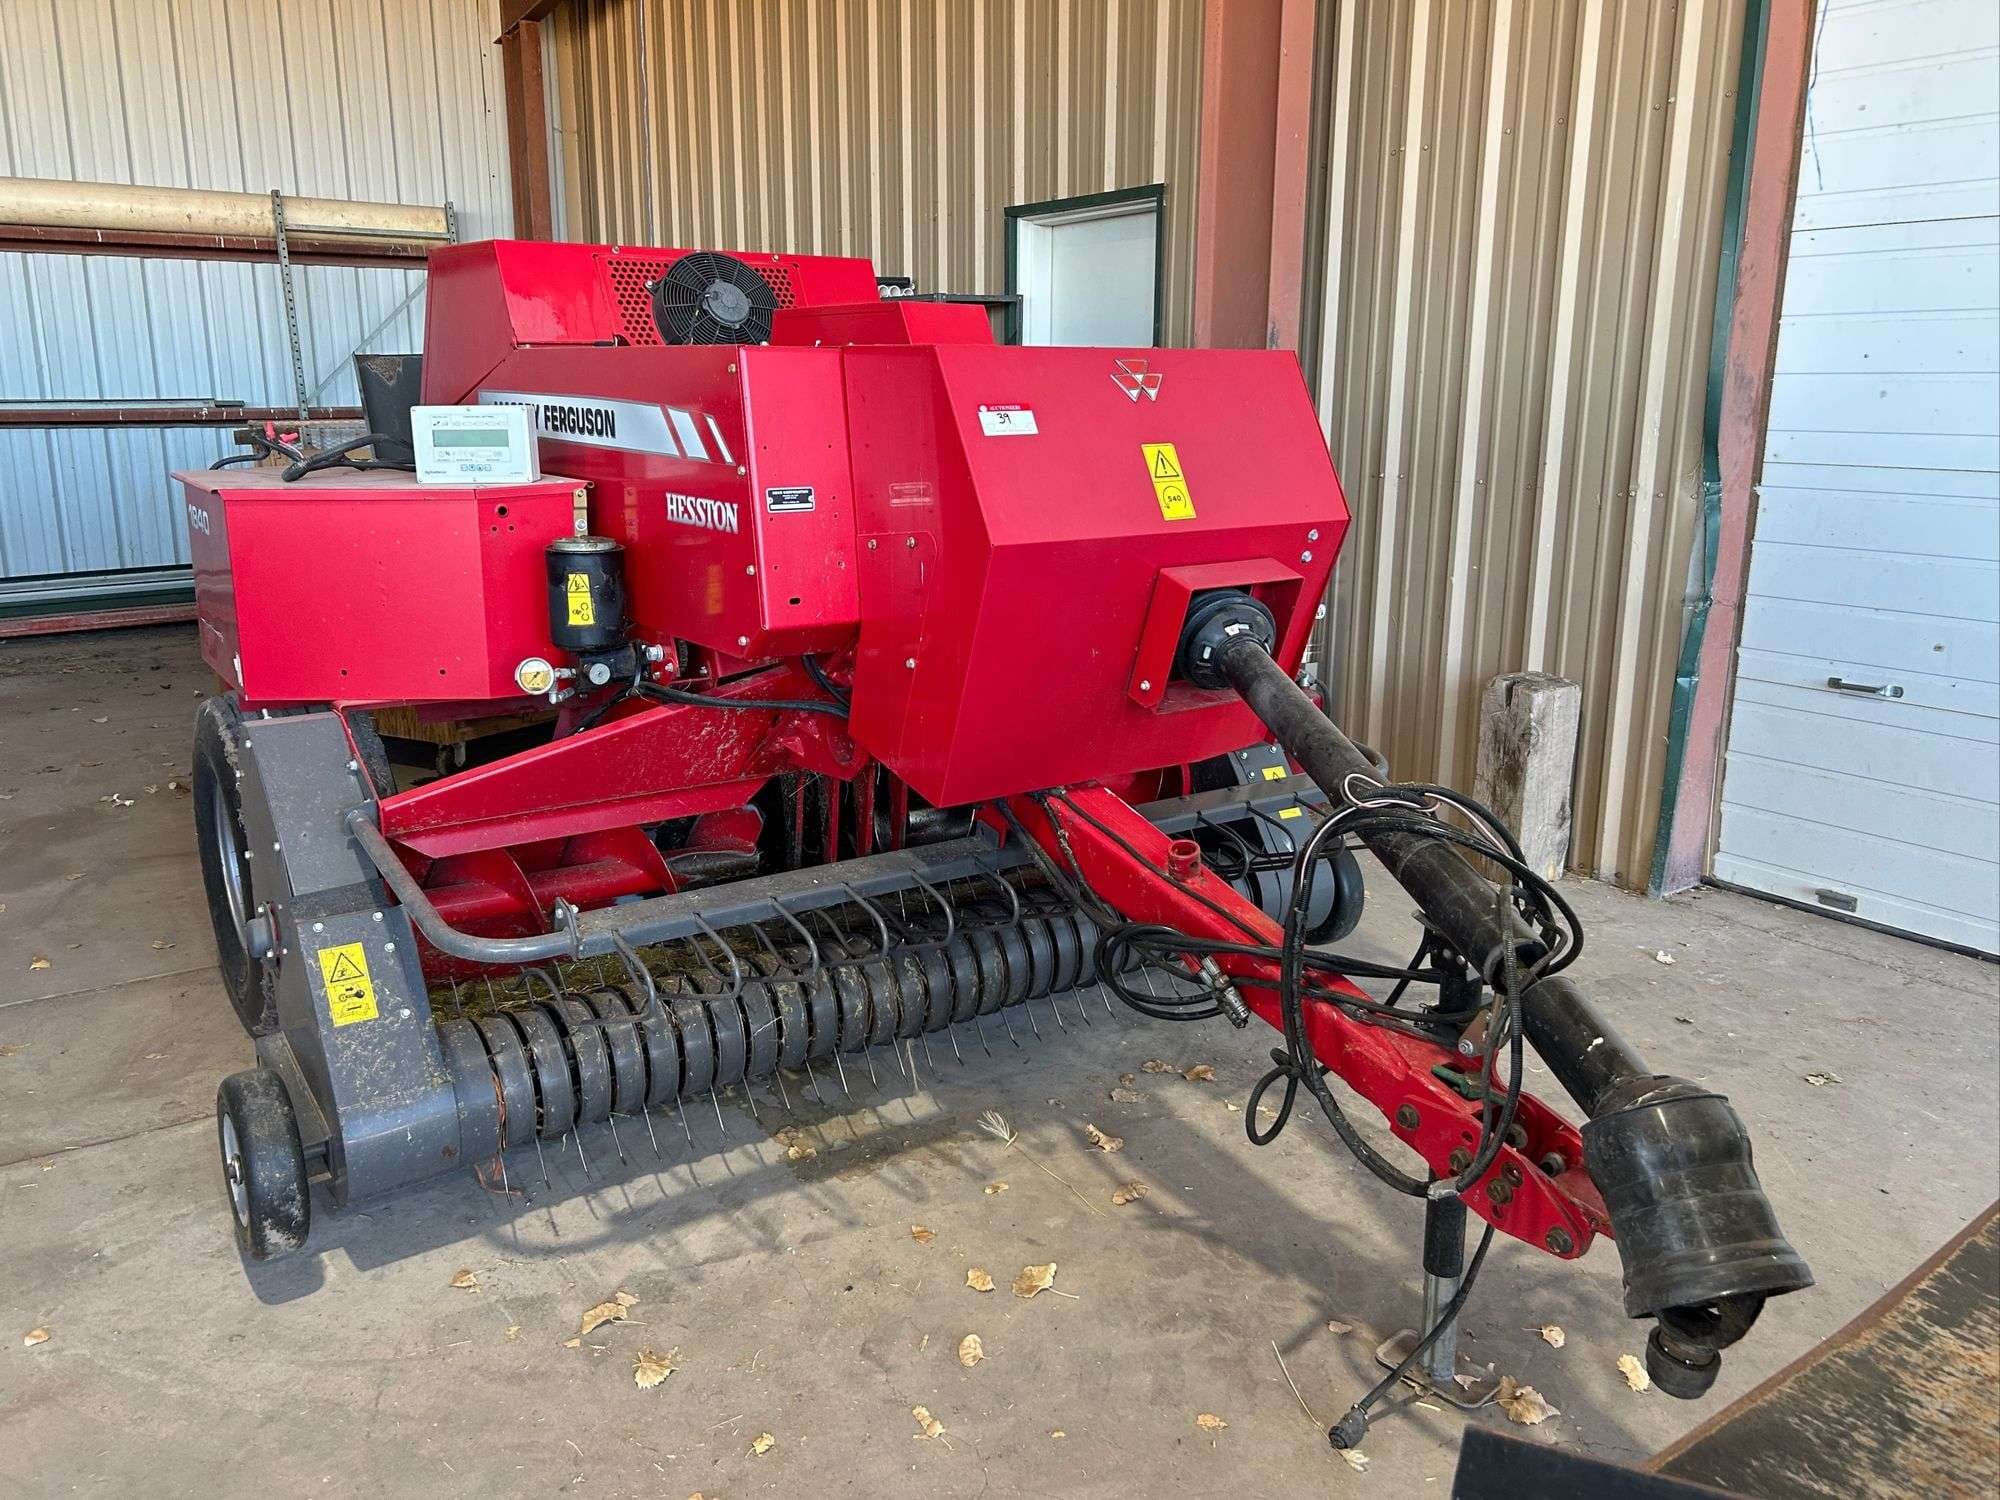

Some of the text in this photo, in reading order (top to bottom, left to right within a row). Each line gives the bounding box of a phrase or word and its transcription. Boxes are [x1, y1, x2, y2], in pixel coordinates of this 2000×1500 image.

[543, 404, 616, 439] FERGUSON
[996, 412, 1012, 425] 39
[665, 492, 739, 535] HESSTON
